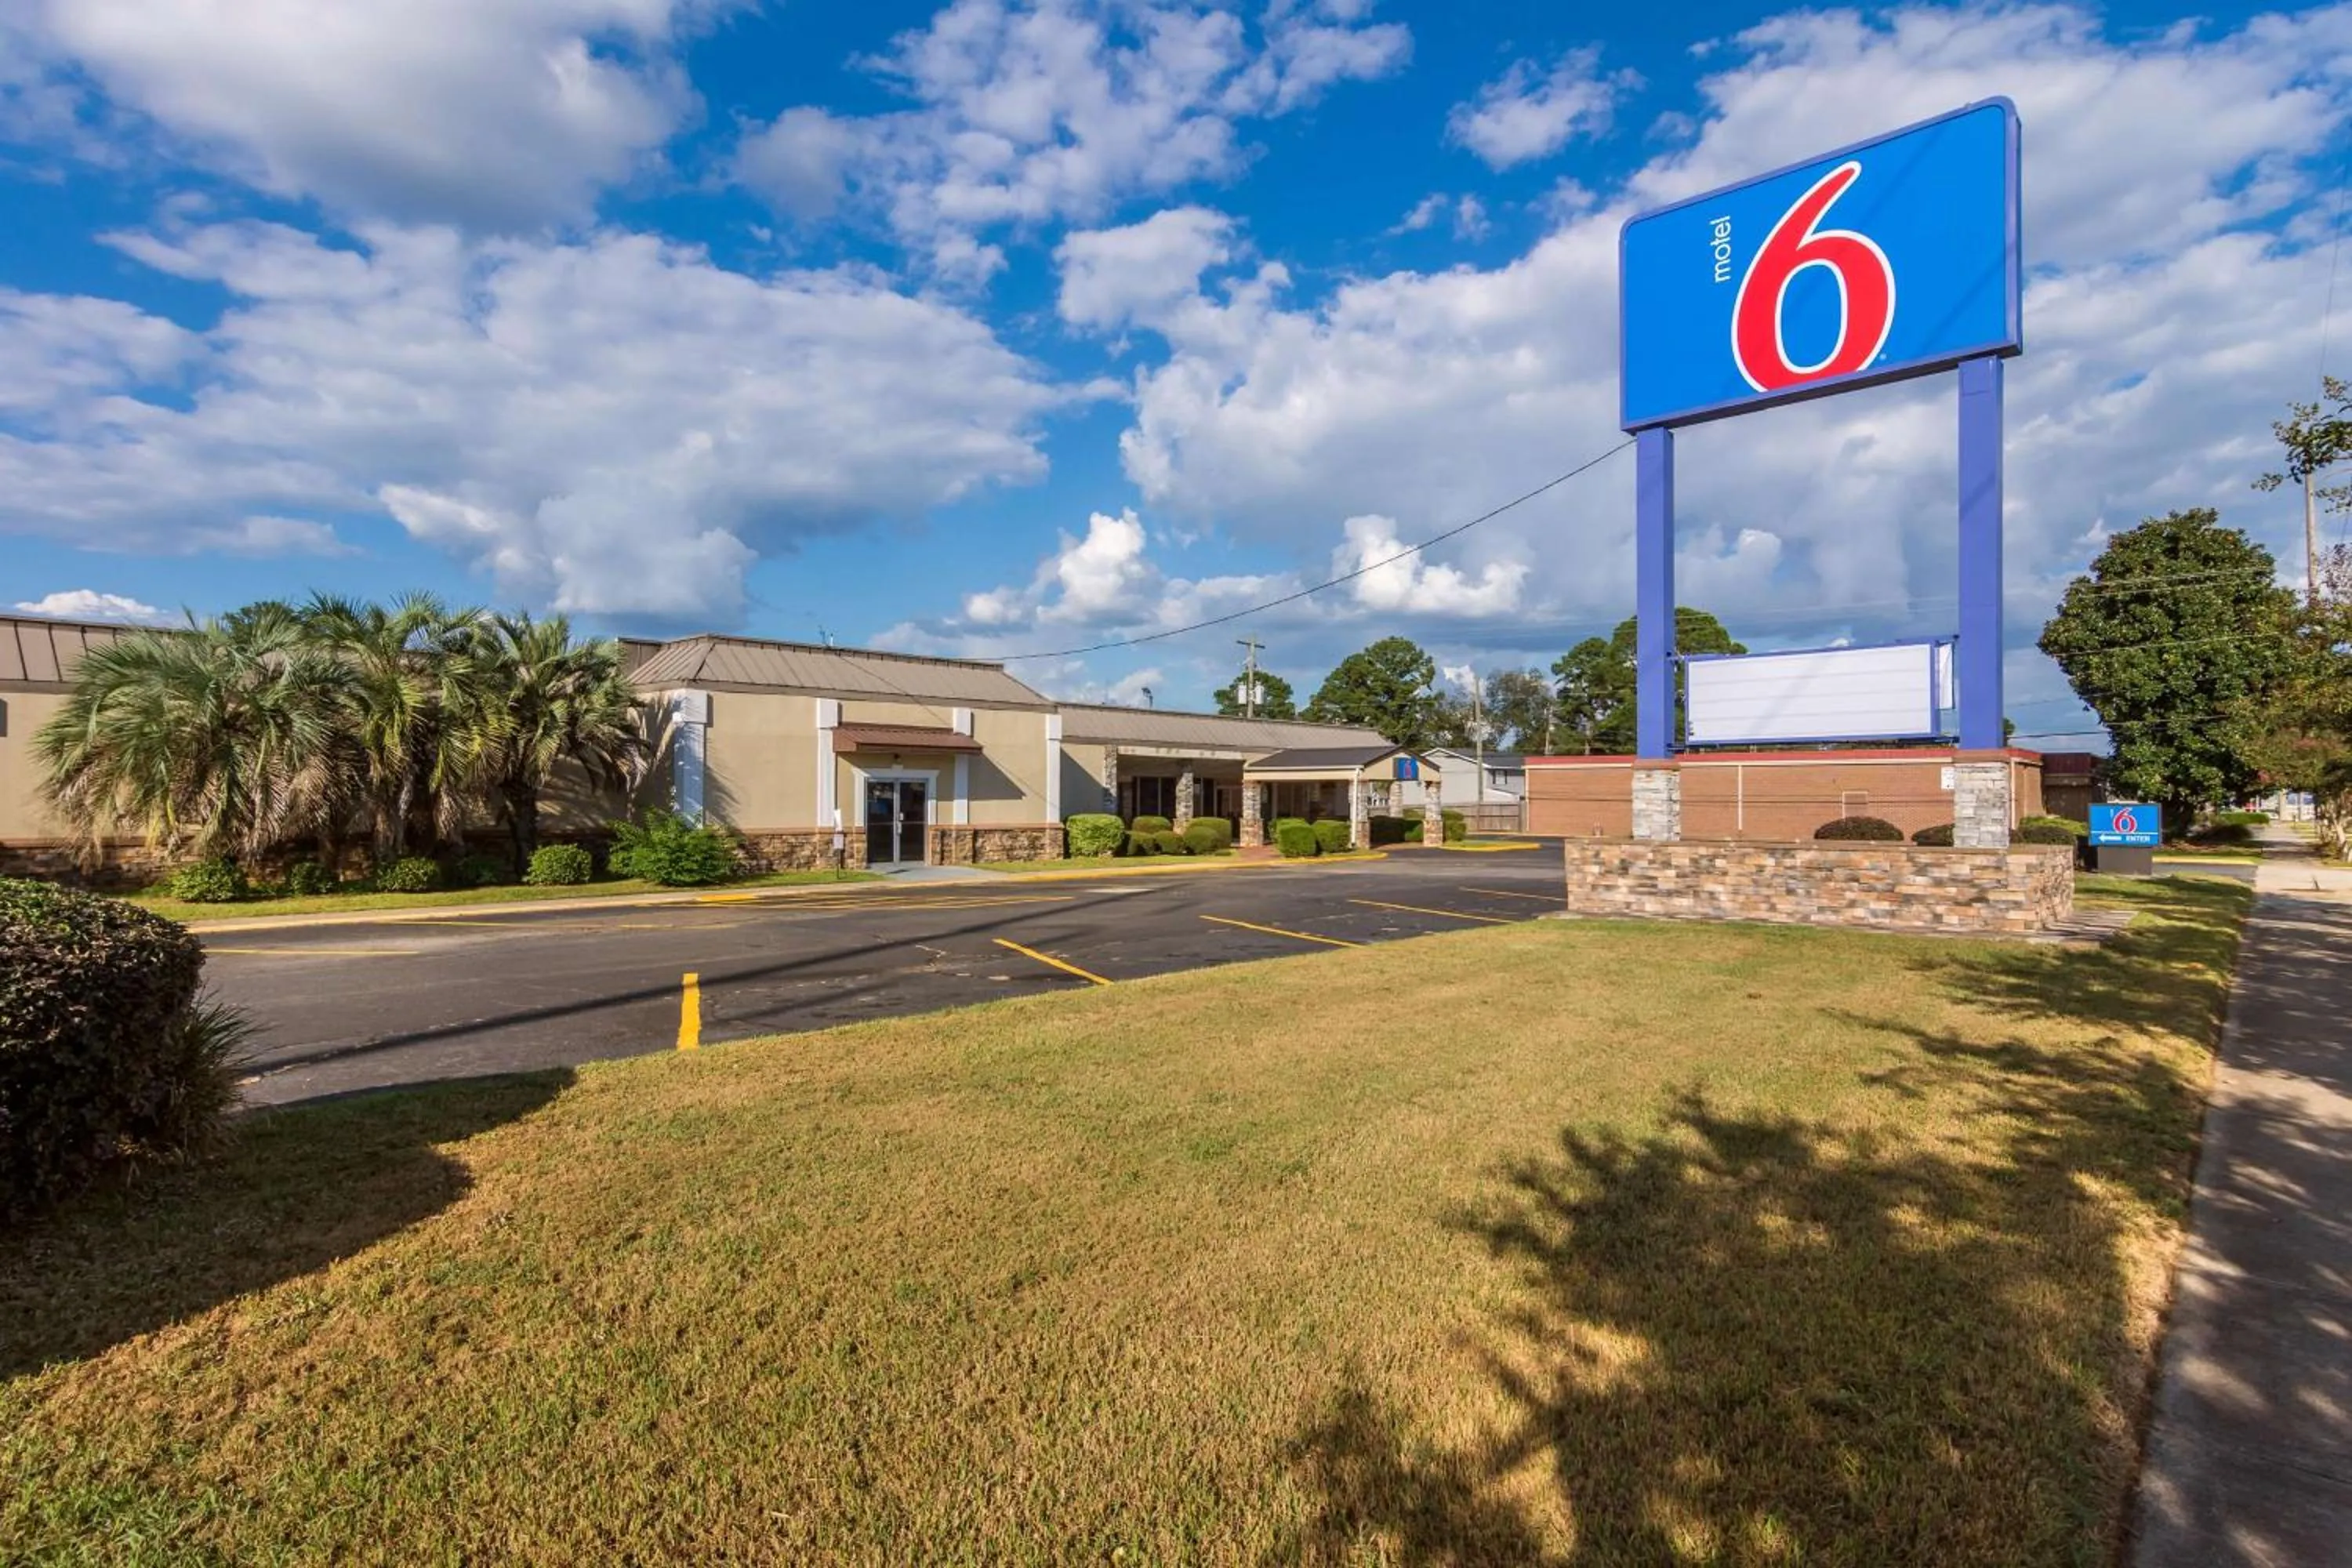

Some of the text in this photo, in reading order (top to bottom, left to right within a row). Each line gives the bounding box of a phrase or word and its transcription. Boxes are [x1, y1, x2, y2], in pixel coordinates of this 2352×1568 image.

[1710, 215, 1732, 284] motel
[1730, 160, 1896, 393] 6
[2113, 806, 2138, 835] 6
